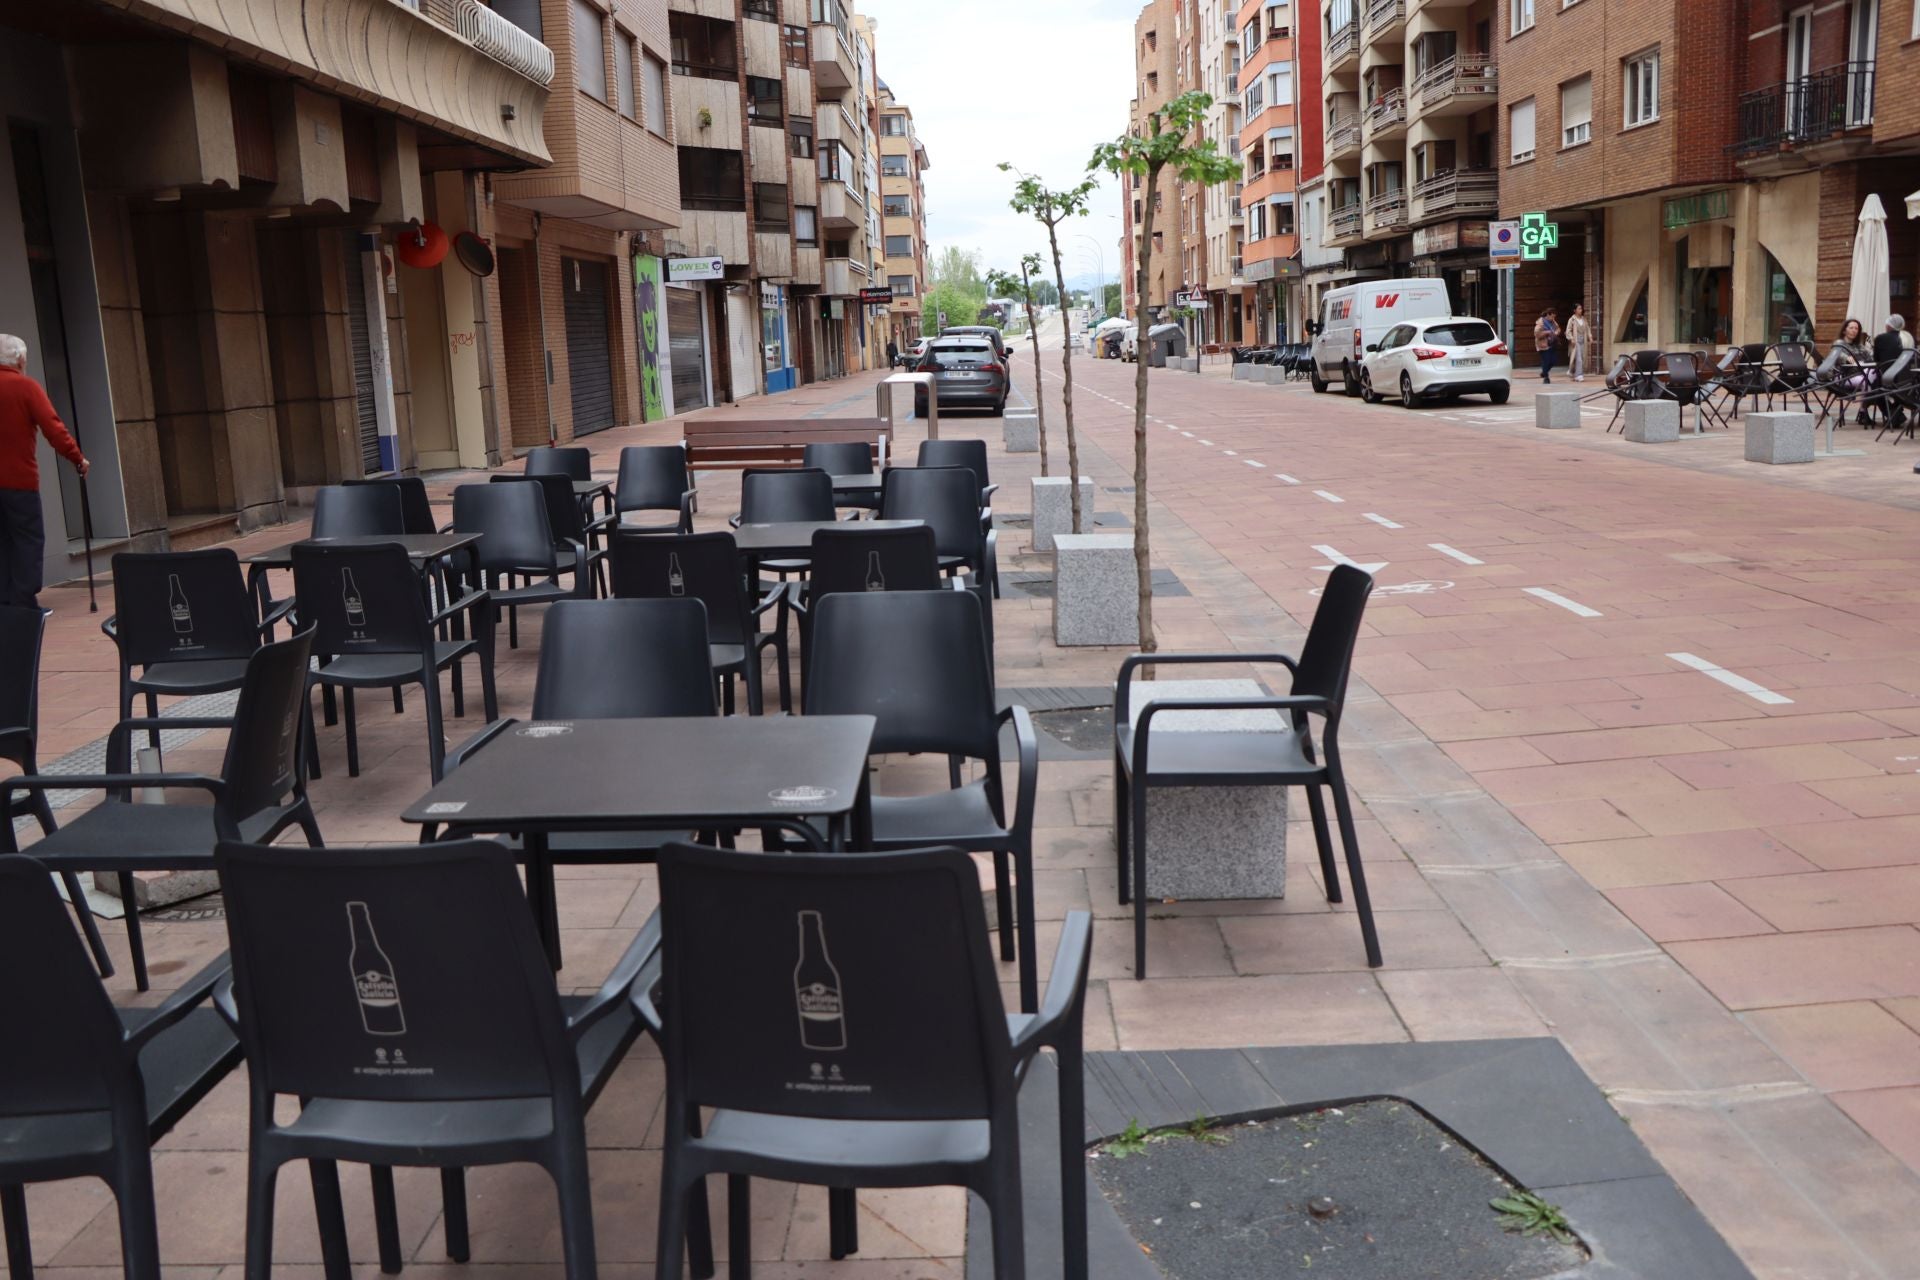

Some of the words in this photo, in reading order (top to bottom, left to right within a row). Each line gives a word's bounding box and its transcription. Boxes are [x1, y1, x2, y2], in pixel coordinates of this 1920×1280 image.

[1522, 227, 1554, 245] GA
[670, 262, 709, 271] LOWEN
[1330, 298, 1353, 320] MRW
